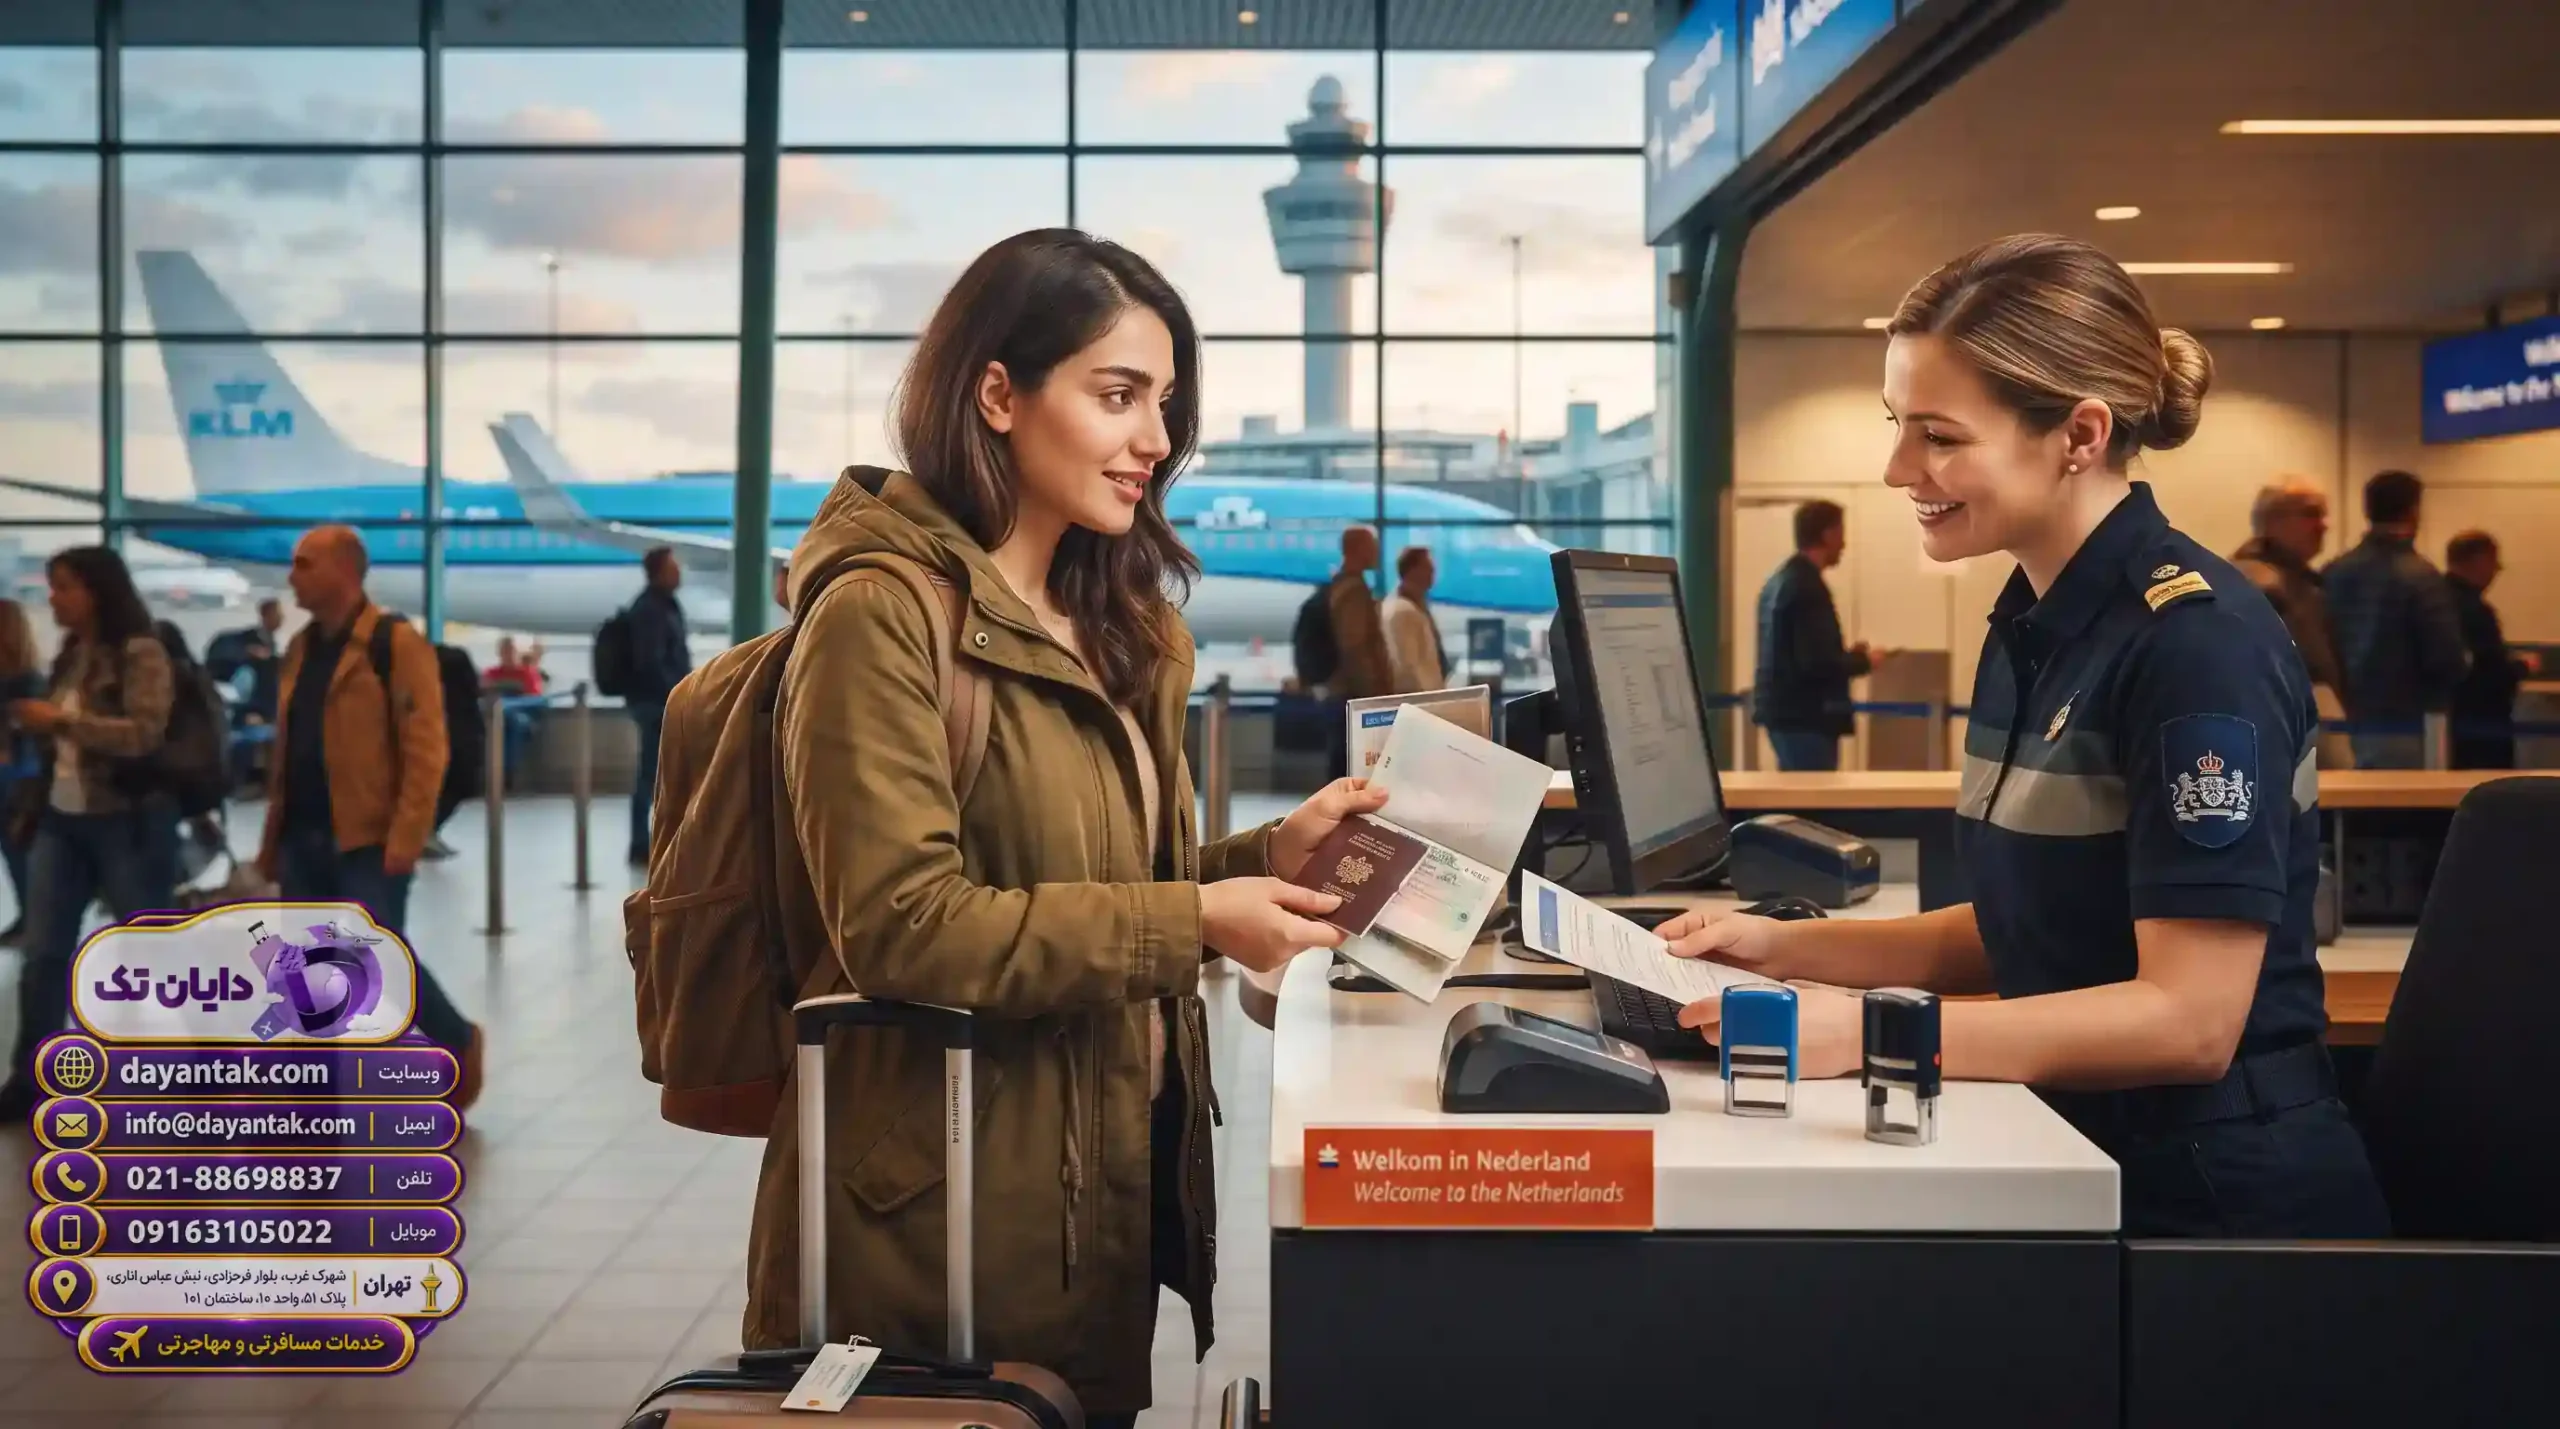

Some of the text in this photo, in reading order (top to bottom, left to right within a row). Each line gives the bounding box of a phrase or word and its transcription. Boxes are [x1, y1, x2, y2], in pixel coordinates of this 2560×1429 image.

[188, 409, 293, 438] KLM
[1353, 1149, 1591, 1171] Welkom in Nederland
[1354, 1180, 1624, 1203] Welcome to the Netherlands
